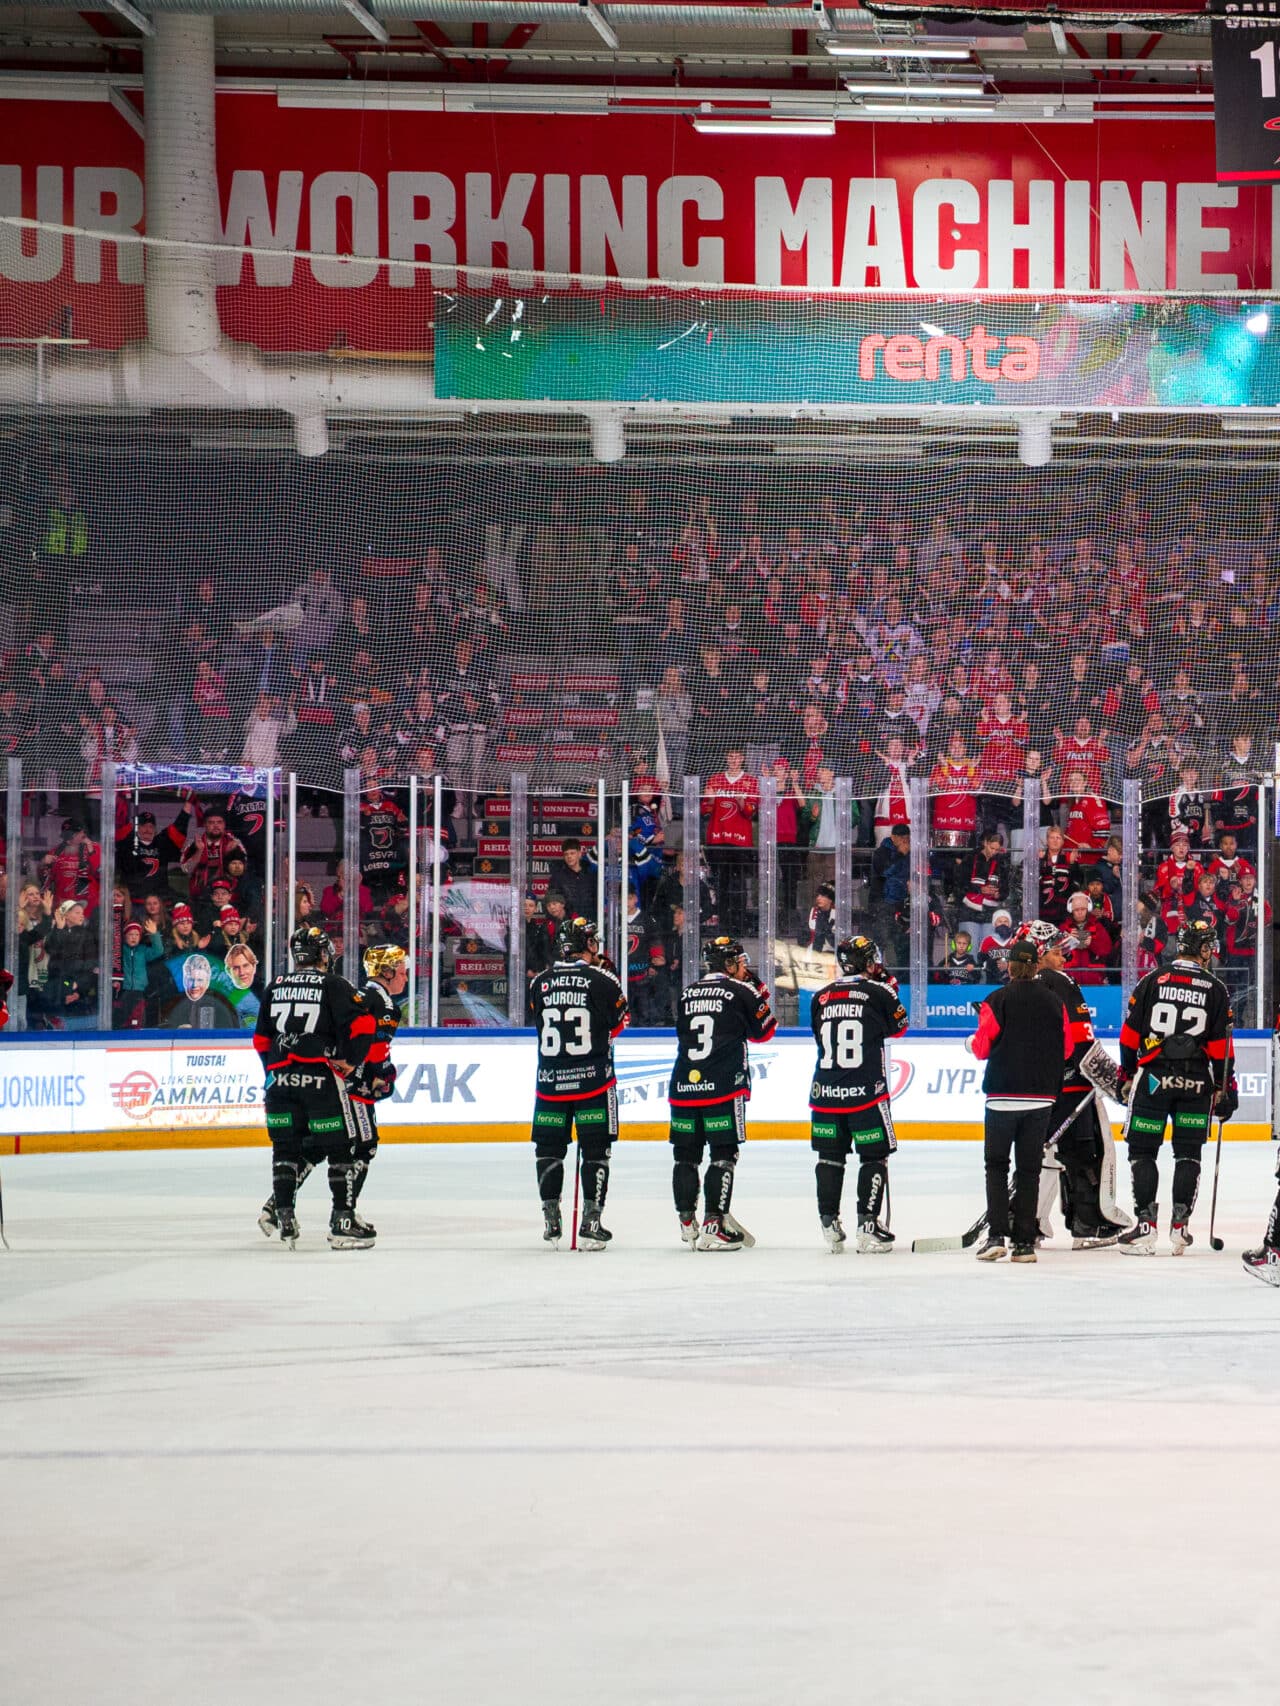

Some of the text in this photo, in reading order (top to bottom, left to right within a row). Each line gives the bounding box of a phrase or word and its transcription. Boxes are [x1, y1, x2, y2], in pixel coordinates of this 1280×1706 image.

[215, 170, 724, 290] WORKING
[754, 177, 1239, 290] MACHINE
[859, 325, 1041, 383] renta
[588, 803, 598, 817] 5
[460, 963, 504, 972] REILUST
[284, 974, 326, 985] MELTEX
[550, 975, 592, 989] MELTEX
[681, 986, 735, 1001] Stemma
[1159, 985, 1207, 1007] VIDGREN
[270, 1003, 321, 1034] 77
[821, 1003, 864, 1020] JOKINEN
[1150, 1002, 1208, 1041] 92
[541, 1007, 593, 1057] 63
[687, 1014, 715, 1062] 3
[820, 1020, 864, 1069] 18
[186, 1055, 226, 1067] TUOSTA!
[161, 1073, 249, 1086] LIIKENNÖINTI
[277, 1072, 327, 1090] KSPT
[677, 1080, 715, 1093] Lumixia
[927, 1068, 986, 1095] JYP.
[1161, 1075, 1205, 1095] KSPT
[821, 1084, 867, 1100] Hidpex
[268, 1116, 290, 1125] ennia
[313, 1119, 341, 1130] fennia
[537, 1113, 564, 1124] fennia
[1135, 1119, 1161, 1131] fennia
[1179, 1115, 1205, 1126] fennia
[339, 1218, 352, 1231] 10
[590, 1220, 600, 1233] 10
[706, 1223, 720, 1235] 10
[863, 1221, 875, 1234] 10
